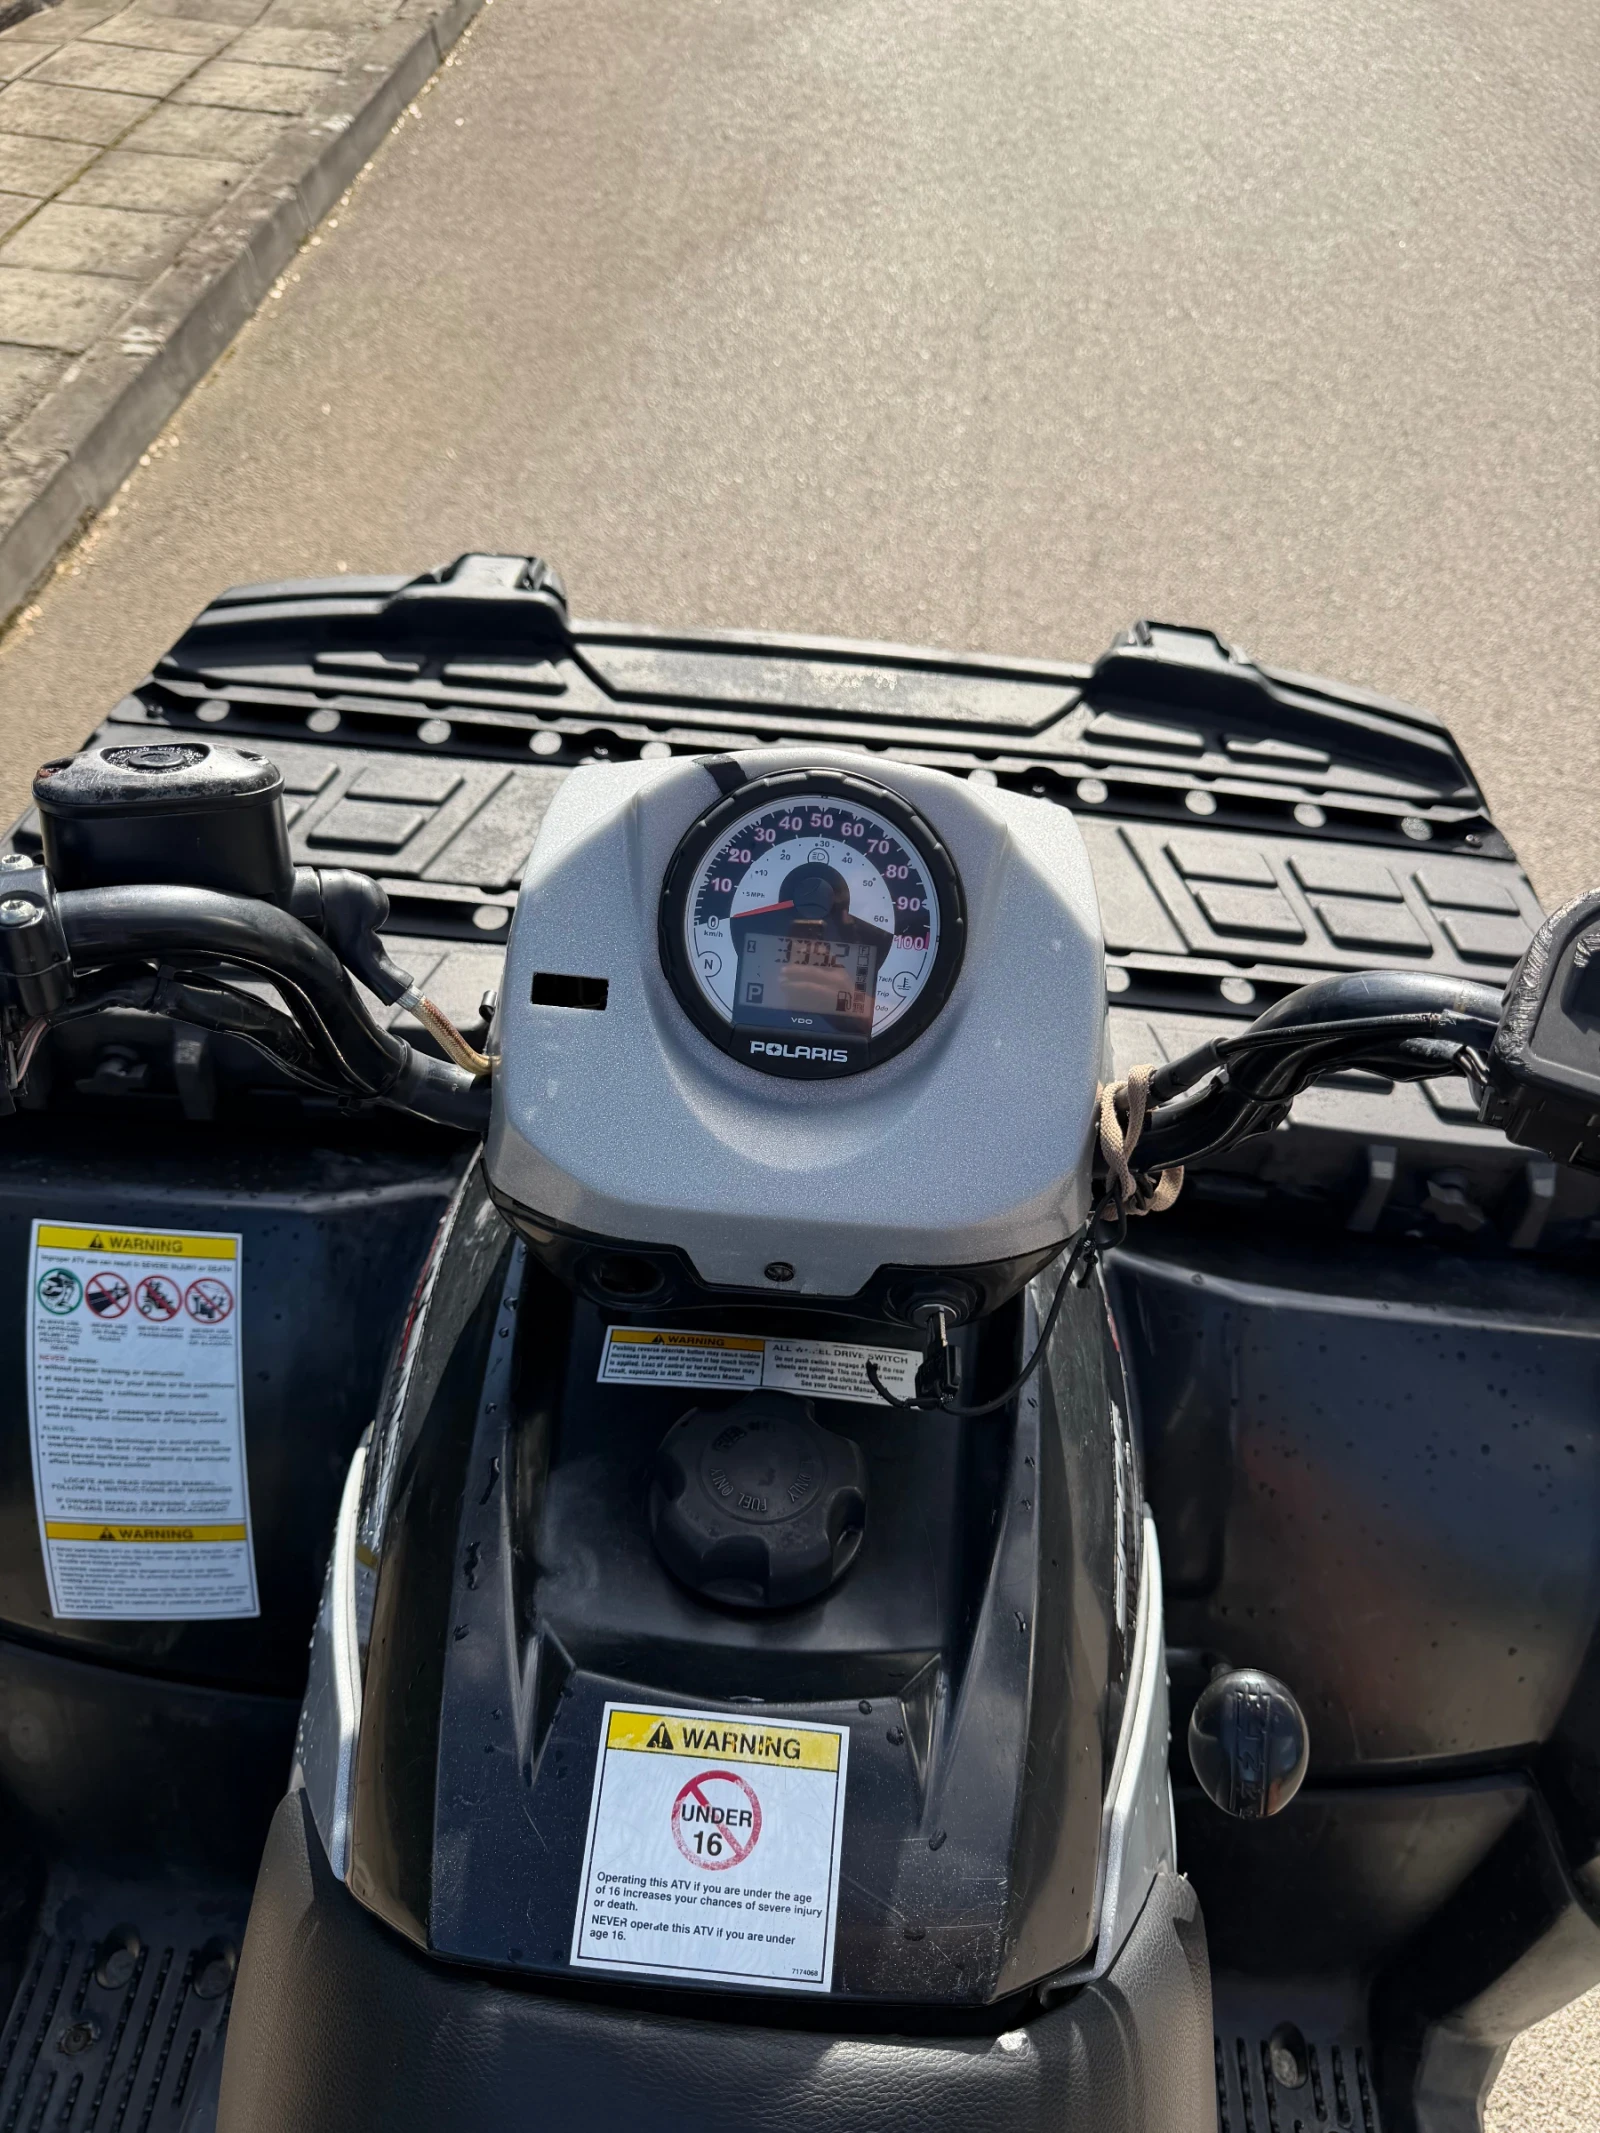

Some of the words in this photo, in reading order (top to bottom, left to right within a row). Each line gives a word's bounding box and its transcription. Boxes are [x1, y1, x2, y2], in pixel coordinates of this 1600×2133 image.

[778, 816, 803, 831] 40
[810, 813, 834, 828] 50
[754, 827, 776, 842] 30
[841, 822, 865, 837] 60
[820, 840, 830, 848] 30
[866, 839, 890, 854] 70
[728, 848, 752, 863] 20
[842, 856, 852, 864] 40
[886, 864, 908, 879] 80
[711, 878, 732, 892] 10
[896, 896, 920, 911] 90
[708, 916, 720, 930] 0
[704, 930, 723, 938] km/h
[894, 934, 924, 950] 100
[704, 959, 713, 970] N
[877, 990, 890, 998] Trip
[750, 1040, 848, 1062] POLARIS
[109, 1235, 183, 1253] WARNING
[667, 1335, 724, 1346] WARNING
[772, 1343, 791, 1351] ALL
[833, 1349, 864, 1358] DRIVE
[867, 1353, 908, 1363] SWITCH
[738, 1492, 767, 1511] FUEL
[118, 1527, 193, 1539] WARNING
[681, 1727, 801, 1759] WARNING
[680, 1803, 753, 1828] UNDER
[691, 1830, 724, 1856] 16
[596, 1871, 647, 1888] Operating
[649, 1876, 668, 1888] this
[670, 1879, 691, 1890] ATV
[693, 1881, 700, 1891] if
[702, 1884, 721, 1896] you
[723, 1886, 740, 1895] are
[743, 1886, 772, 1899] under
[774, 1890, 790, 1901] the
[793, 1893, 812, 1905] age
[593, 1899, 604, 1907] or
[606, 1898, 638, 1911] death.
[595, 1884, 606, 1894] of
[608, 1885, 620, 1896] 16
[623, 1887, 672, 1901] increases
[674, 1894, 697, 1906] your
[699, 1895, 742, 1909] chances
[745, 1900, 756, 1910] of
[758, 1903, 791, 1913] severe
[794, 1905, 822, 1918] injury
[589, 1929, 608, 1941] age
[611, 1930, 626, 1940] 16.
[591, 1914, 627, 1927] NEVER
[629, 1919, 669, 1933] operate
[671, 1922, 690, 1934] this
[693, 1924, 714, 1936] ATV
[716, 1927, 723, 1937] if
[725, 1929, 744, 1942] you
[747, 1931, 764, 1941] are
[765, 1932, 795, 1945] under
